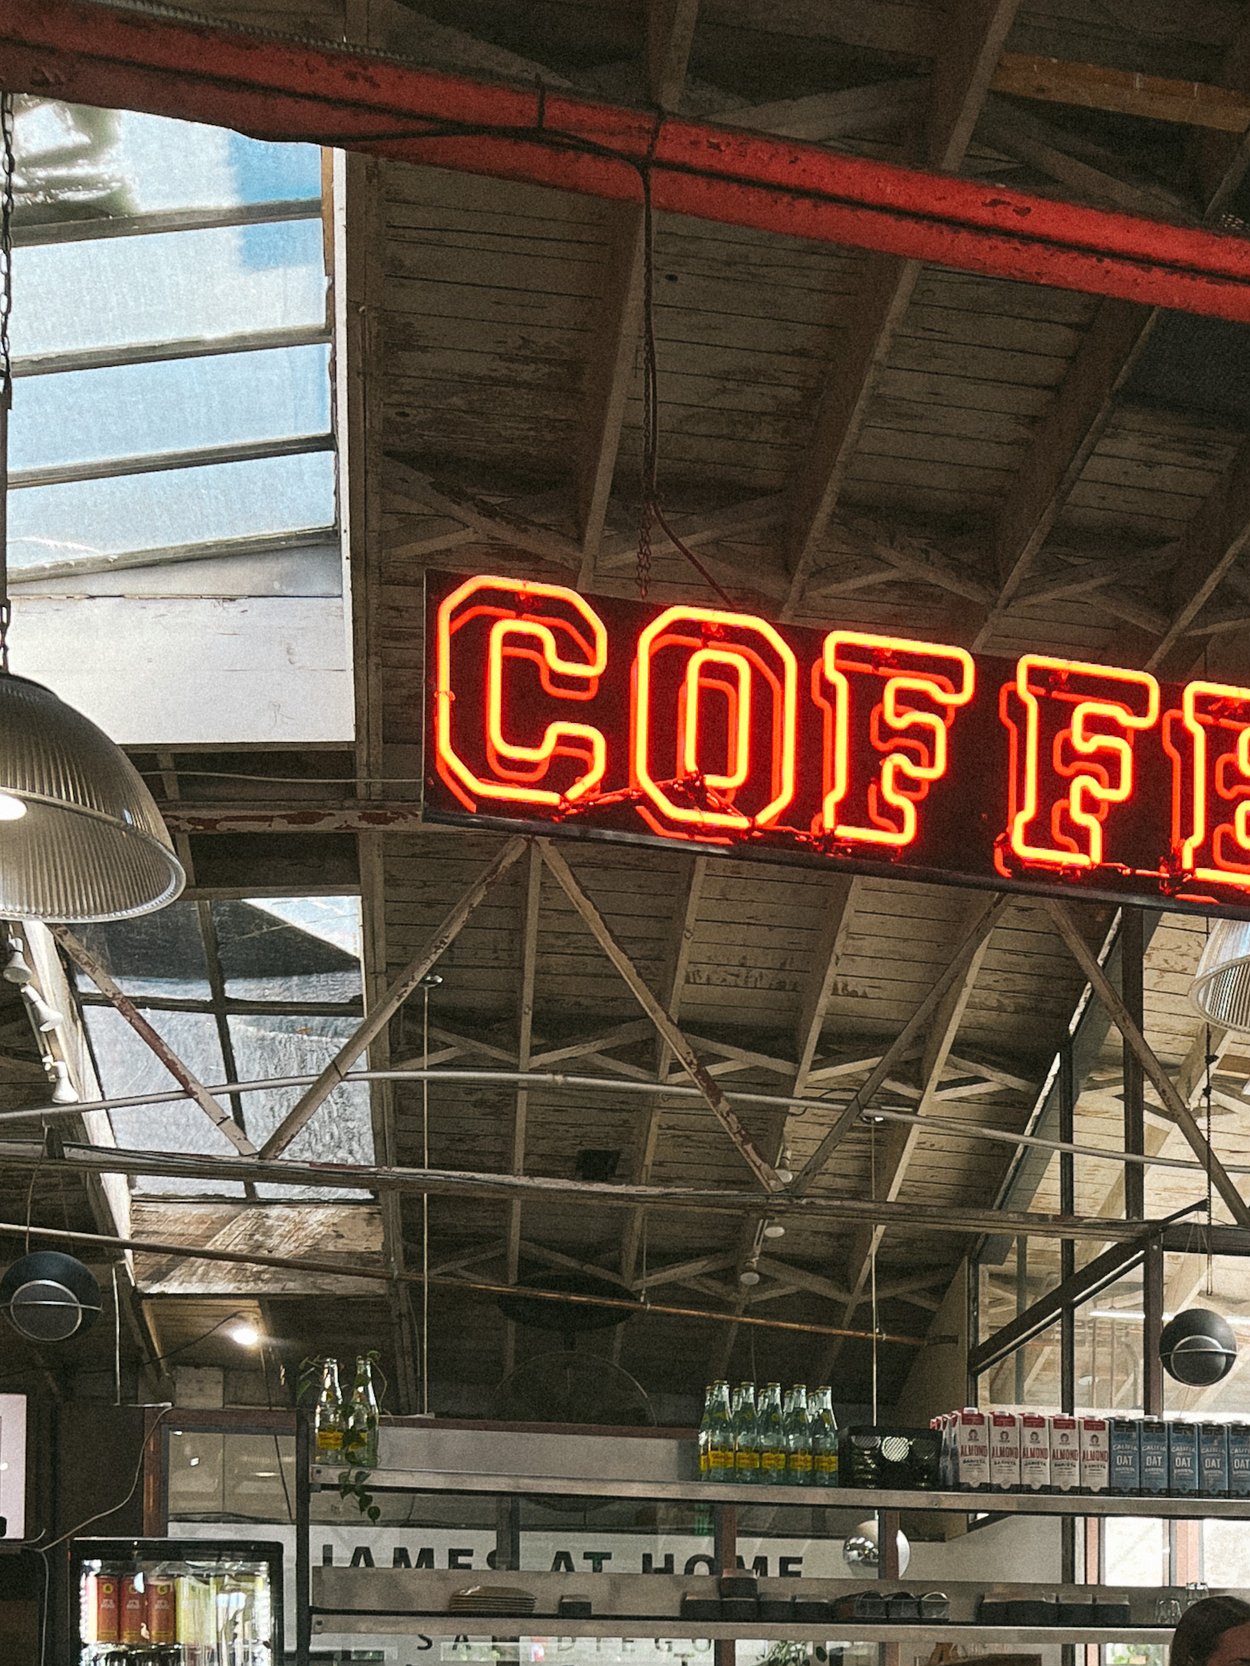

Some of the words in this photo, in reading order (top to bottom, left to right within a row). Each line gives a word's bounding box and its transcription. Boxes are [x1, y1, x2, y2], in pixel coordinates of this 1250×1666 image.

[1116, 1455, 1133, 1466] OAT
[1146, 1456, 1162, 1466] OAT
[1175, 1456, 1192, 1467] OAT
[1204, 1458, 1221, 1469] OAT
[1233, 1458, 1250, 1470] OAT
